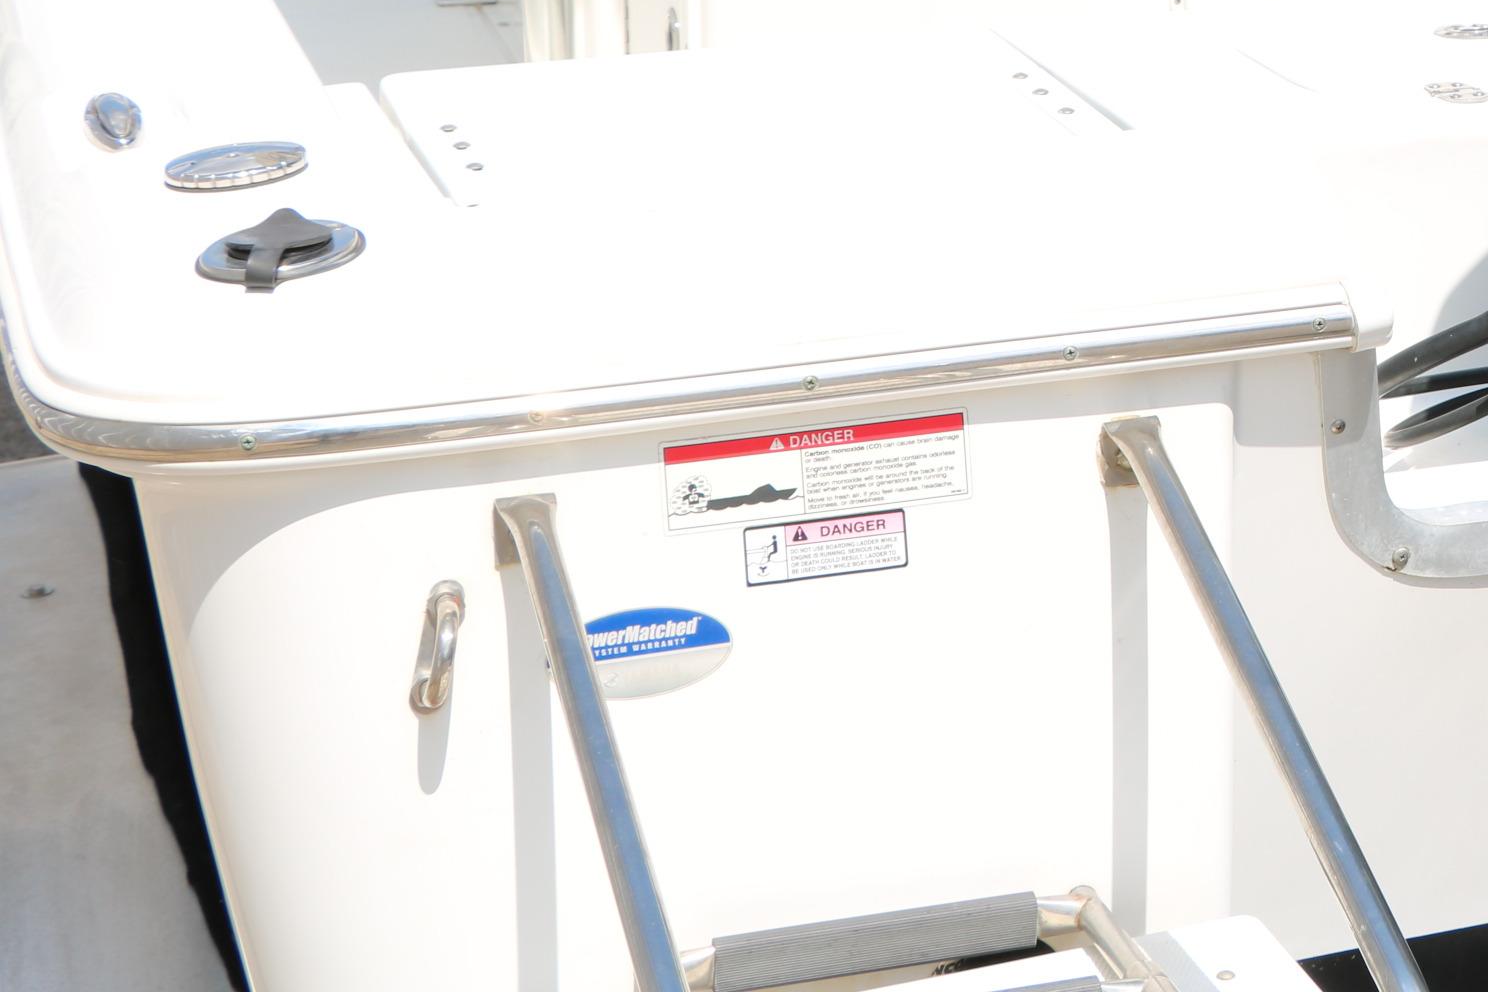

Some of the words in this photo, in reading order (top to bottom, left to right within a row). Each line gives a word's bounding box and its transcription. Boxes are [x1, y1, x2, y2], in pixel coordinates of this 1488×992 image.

[789, 429, 855, 448] DANGER
[832, 446, 864, 454] monoxide
[866, 443, 882, 451] (CO)
[820, 519, 886, 537] DANGER
[593, 645, 628, 657] YSTEM
[632, 638, 686, 652] WARRANTY
